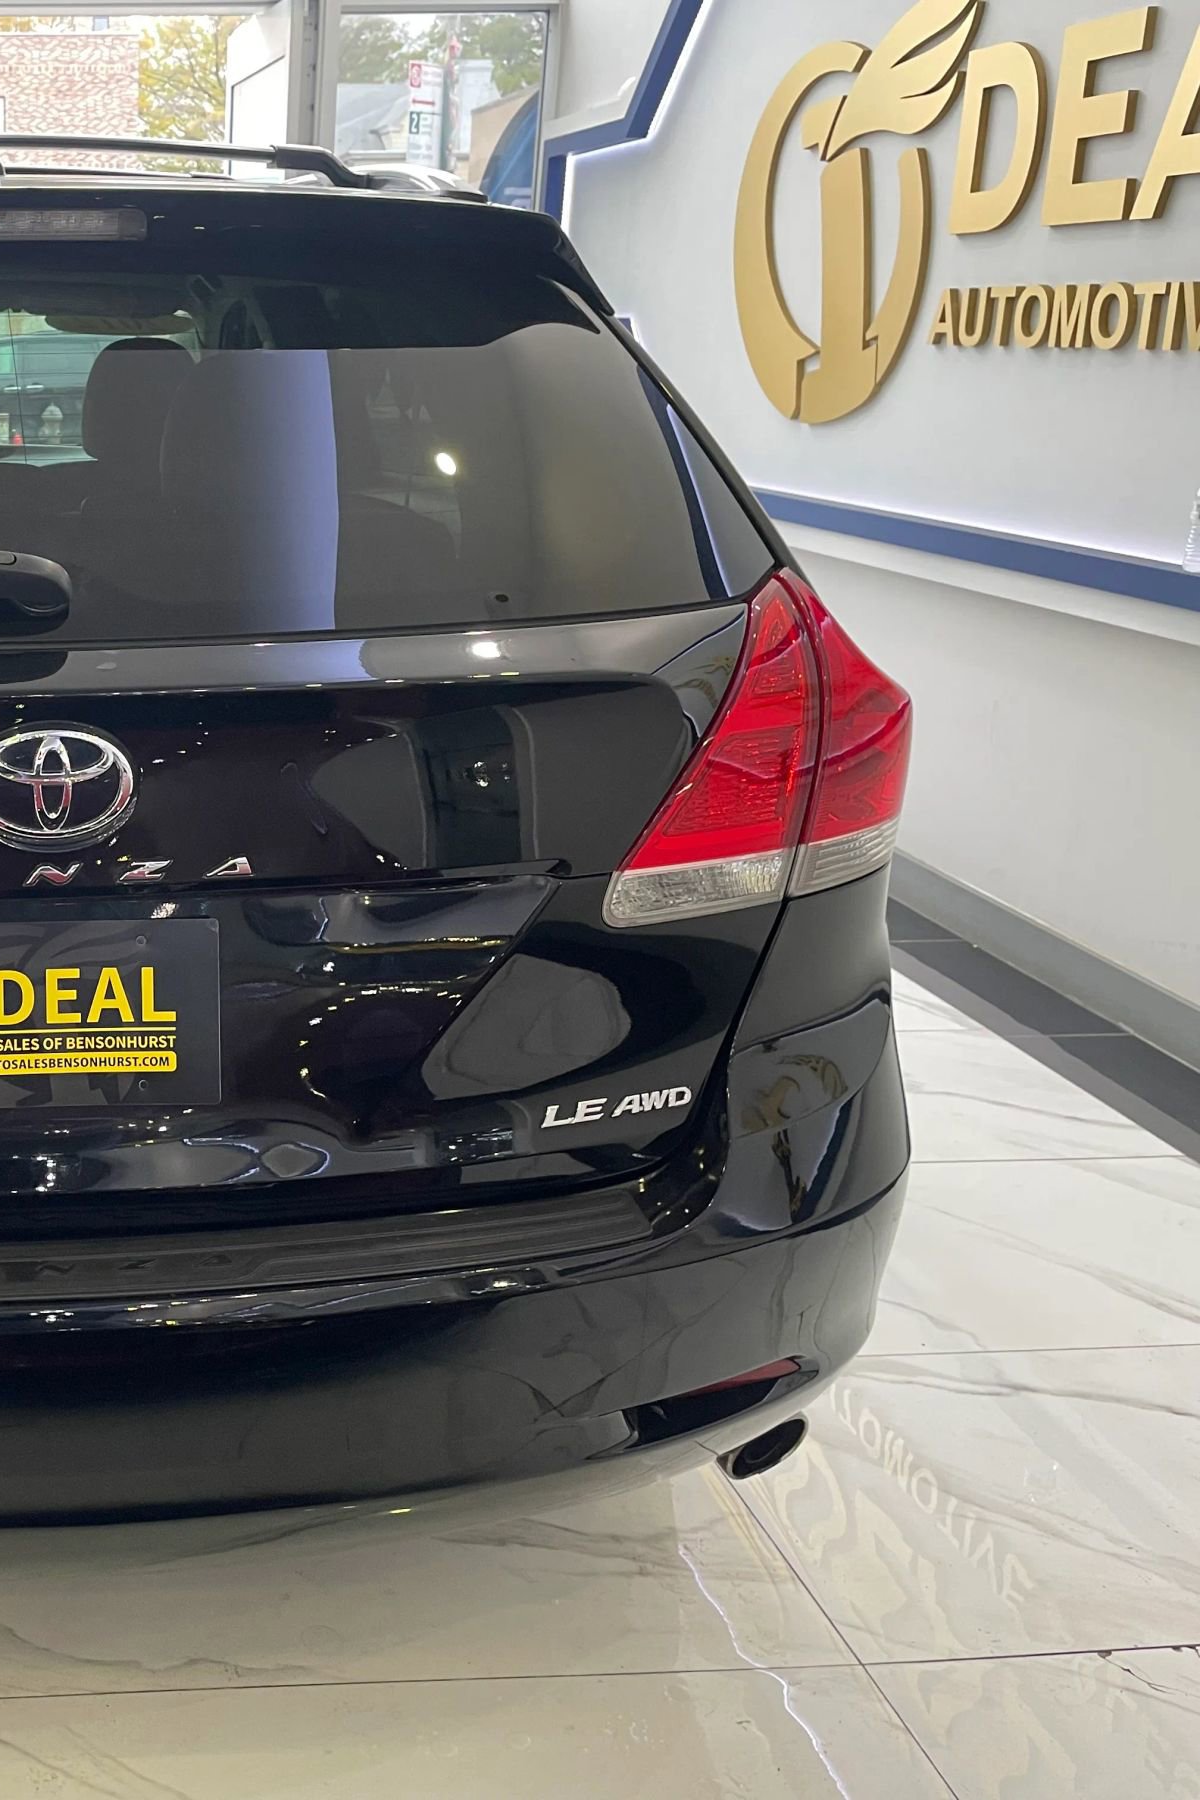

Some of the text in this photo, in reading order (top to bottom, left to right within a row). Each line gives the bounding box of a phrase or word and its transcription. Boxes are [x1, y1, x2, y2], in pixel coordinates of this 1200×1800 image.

[42, 1037, 62, 1050] OF
[67, 1035, 177, 1050] BENSONHURST
[541, 1086, 693, 1128] LE AWD
